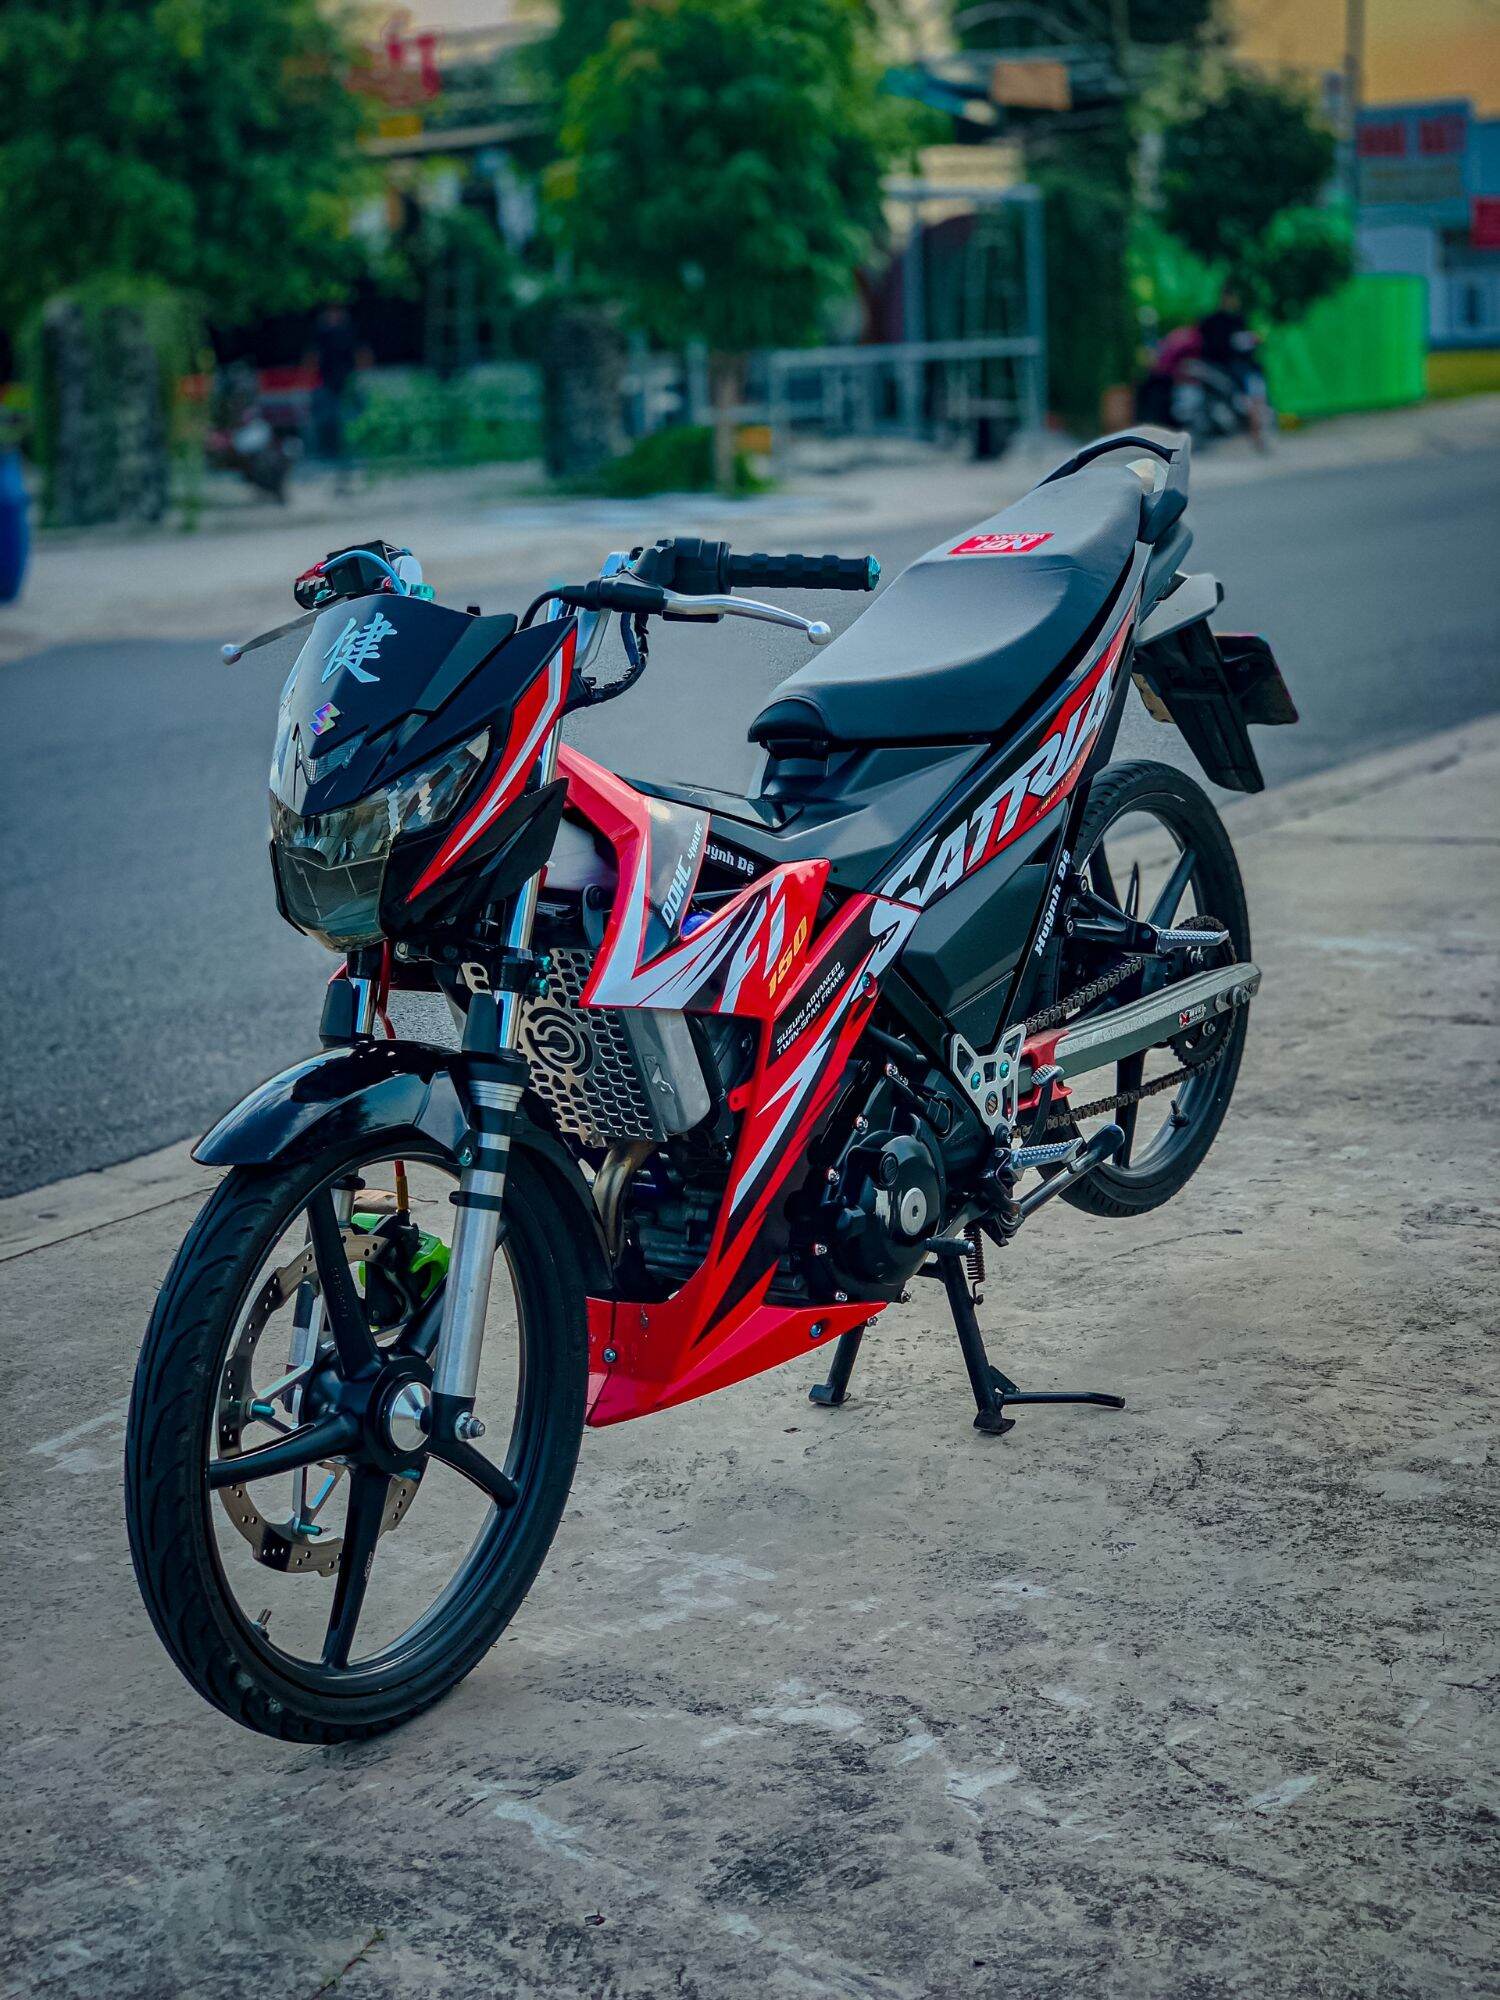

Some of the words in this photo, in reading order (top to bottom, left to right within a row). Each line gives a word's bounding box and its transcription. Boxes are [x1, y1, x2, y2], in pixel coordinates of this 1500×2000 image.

[704, 844, 735, 866] uỳnh
[854, 666, 1112, 990] SATRIA
[661, 854, 692, 929] DOHC
[768, 916, 808, 999] 150
[776, 1009, 805, 1047] SUZUKI
[806, 961, 841, 1012] ADVANCED
[776, 1000, 821, 1056] TWIN-SPAN
[820, 967, 846, 1003] FRAME
